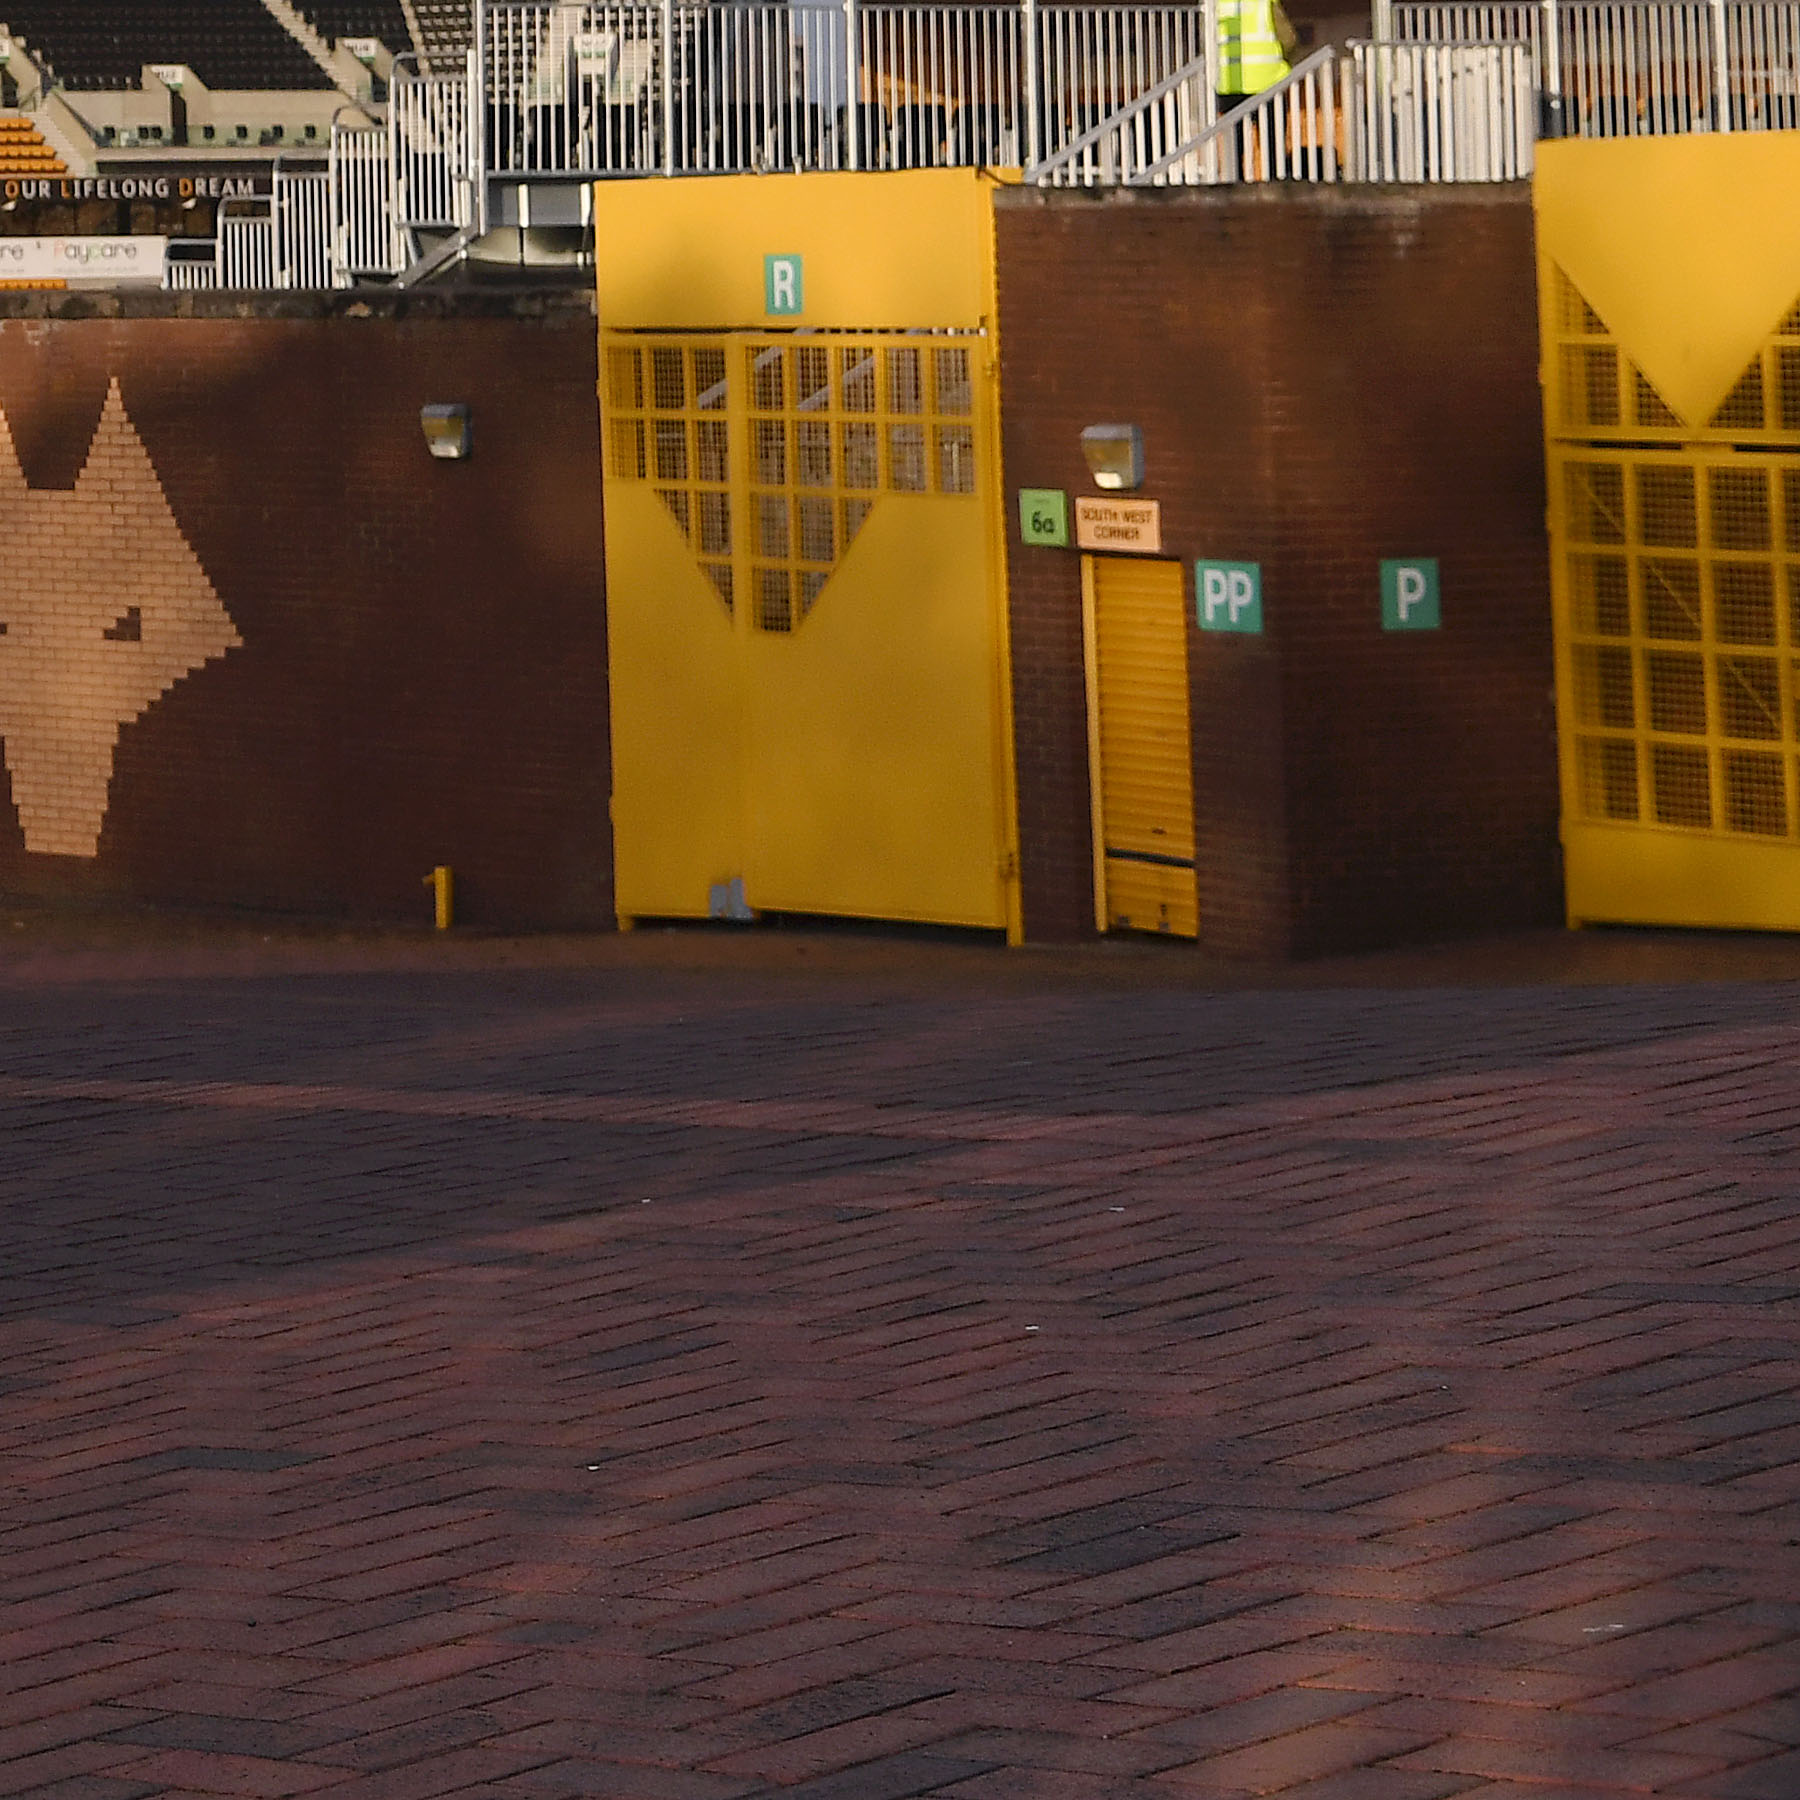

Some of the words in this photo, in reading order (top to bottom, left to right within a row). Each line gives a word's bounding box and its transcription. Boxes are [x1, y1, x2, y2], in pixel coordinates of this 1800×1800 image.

[4, 179, 50, 199] OUR
[60, 178, 169, 198] LIFELONG
[178, 178, 254, 197] DREAM
[773, 260, 795, 309] R
[1032, 511, 1055, 534] 6a
[1080, 507, 1118, 523] SOUTH
[1121, 509, 1152, 524] WEST
[1093, 525, 1140, 541] CORNER
[1203, 568, 1253, 623] PP
[1397, 567, 1426, 622] P
